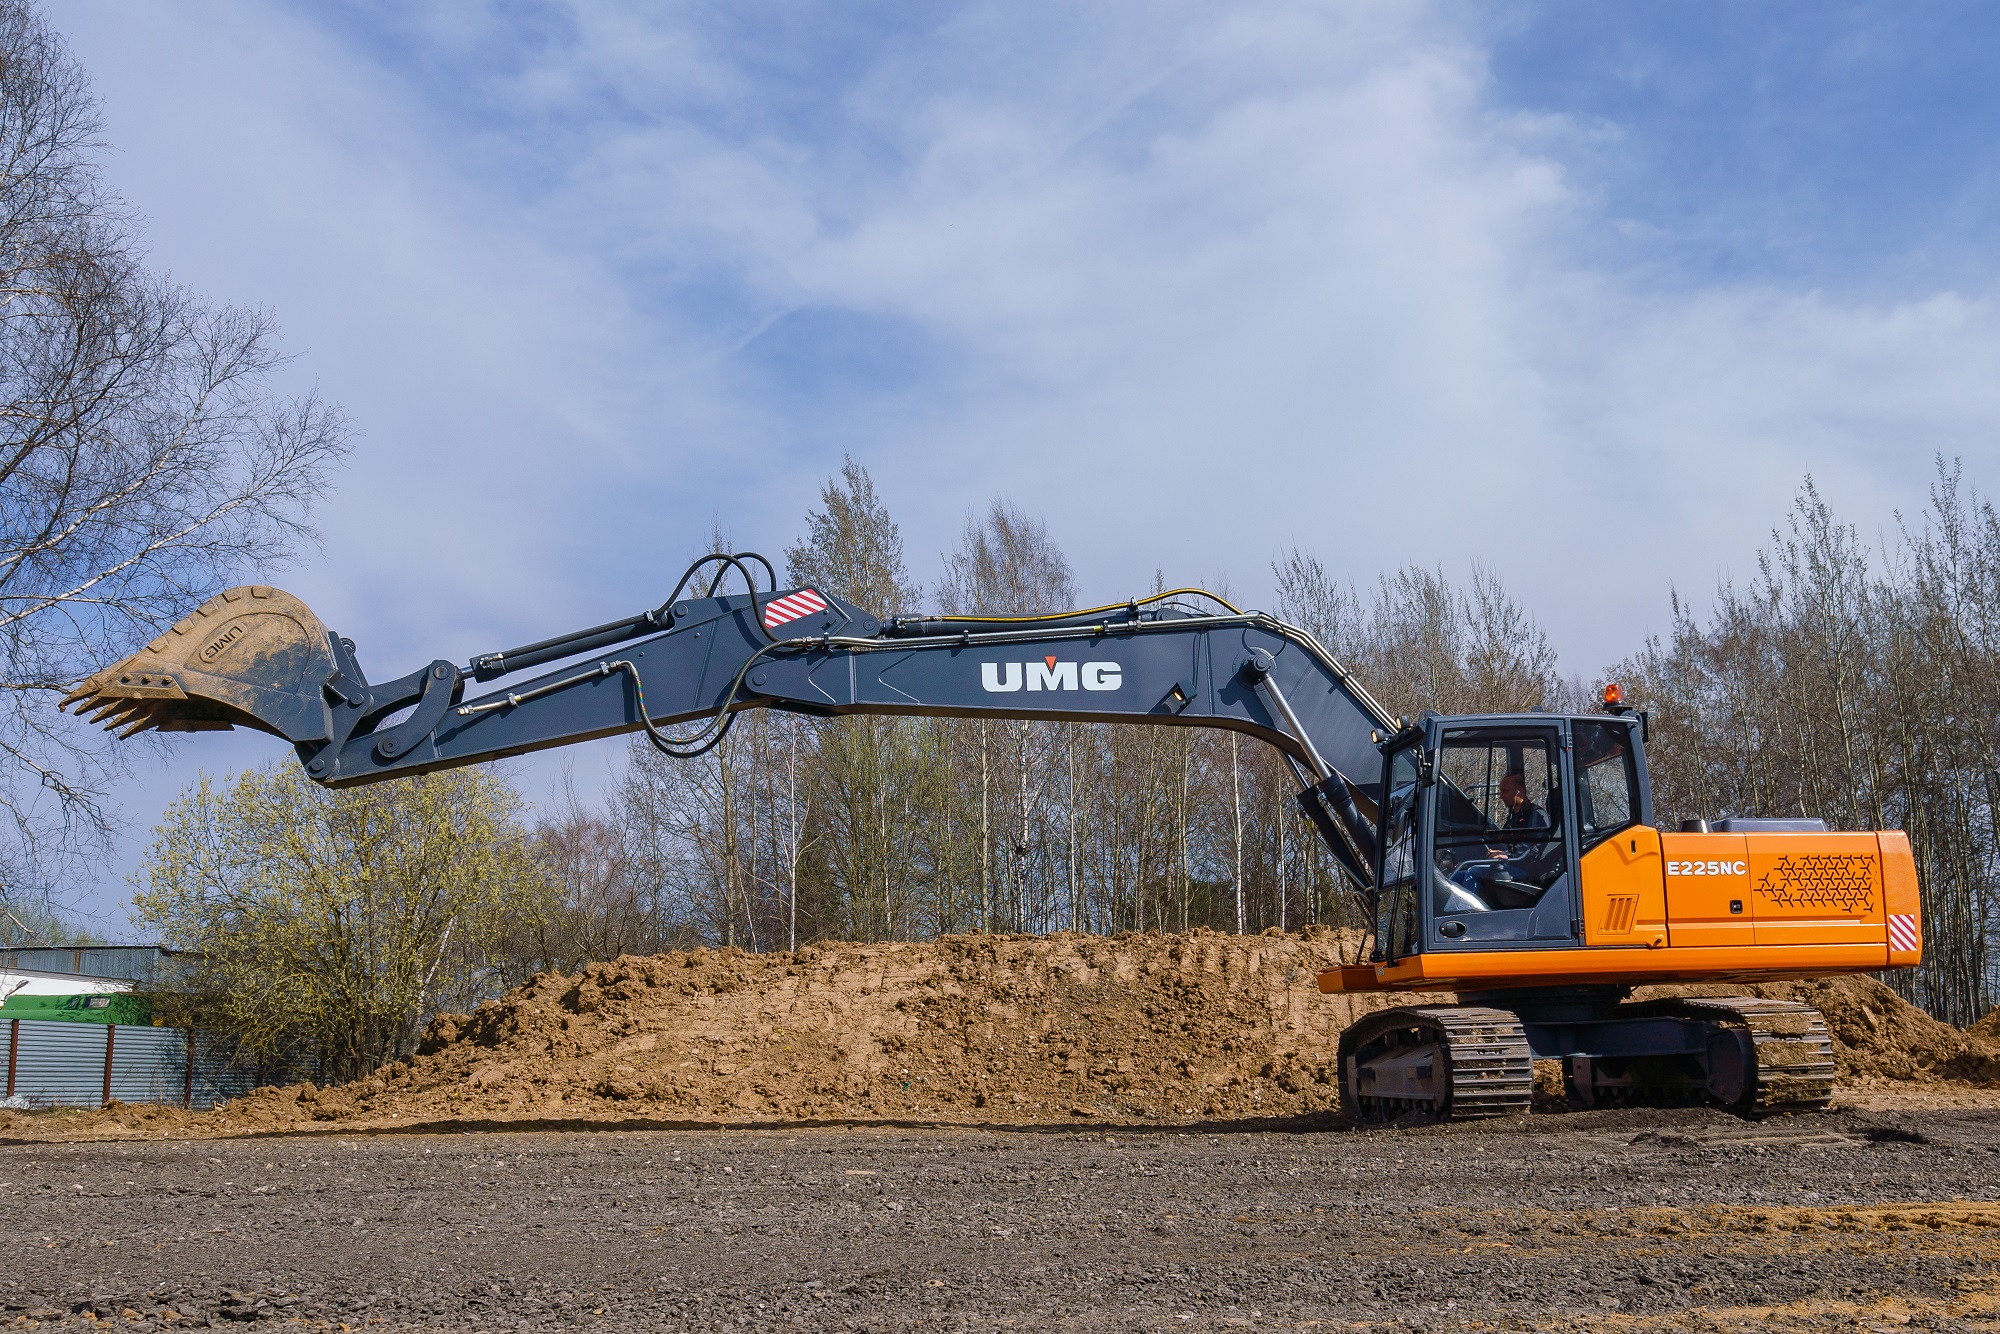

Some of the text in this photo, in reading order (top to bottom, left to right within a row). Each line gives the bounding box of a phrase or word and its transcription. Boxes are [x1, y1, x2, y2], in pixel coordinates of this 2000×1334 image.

[204, 626, 243, 658] UMG
[981, 660, 1122, 692] UMG
[1666, 860, 1747, 876] E225NC
